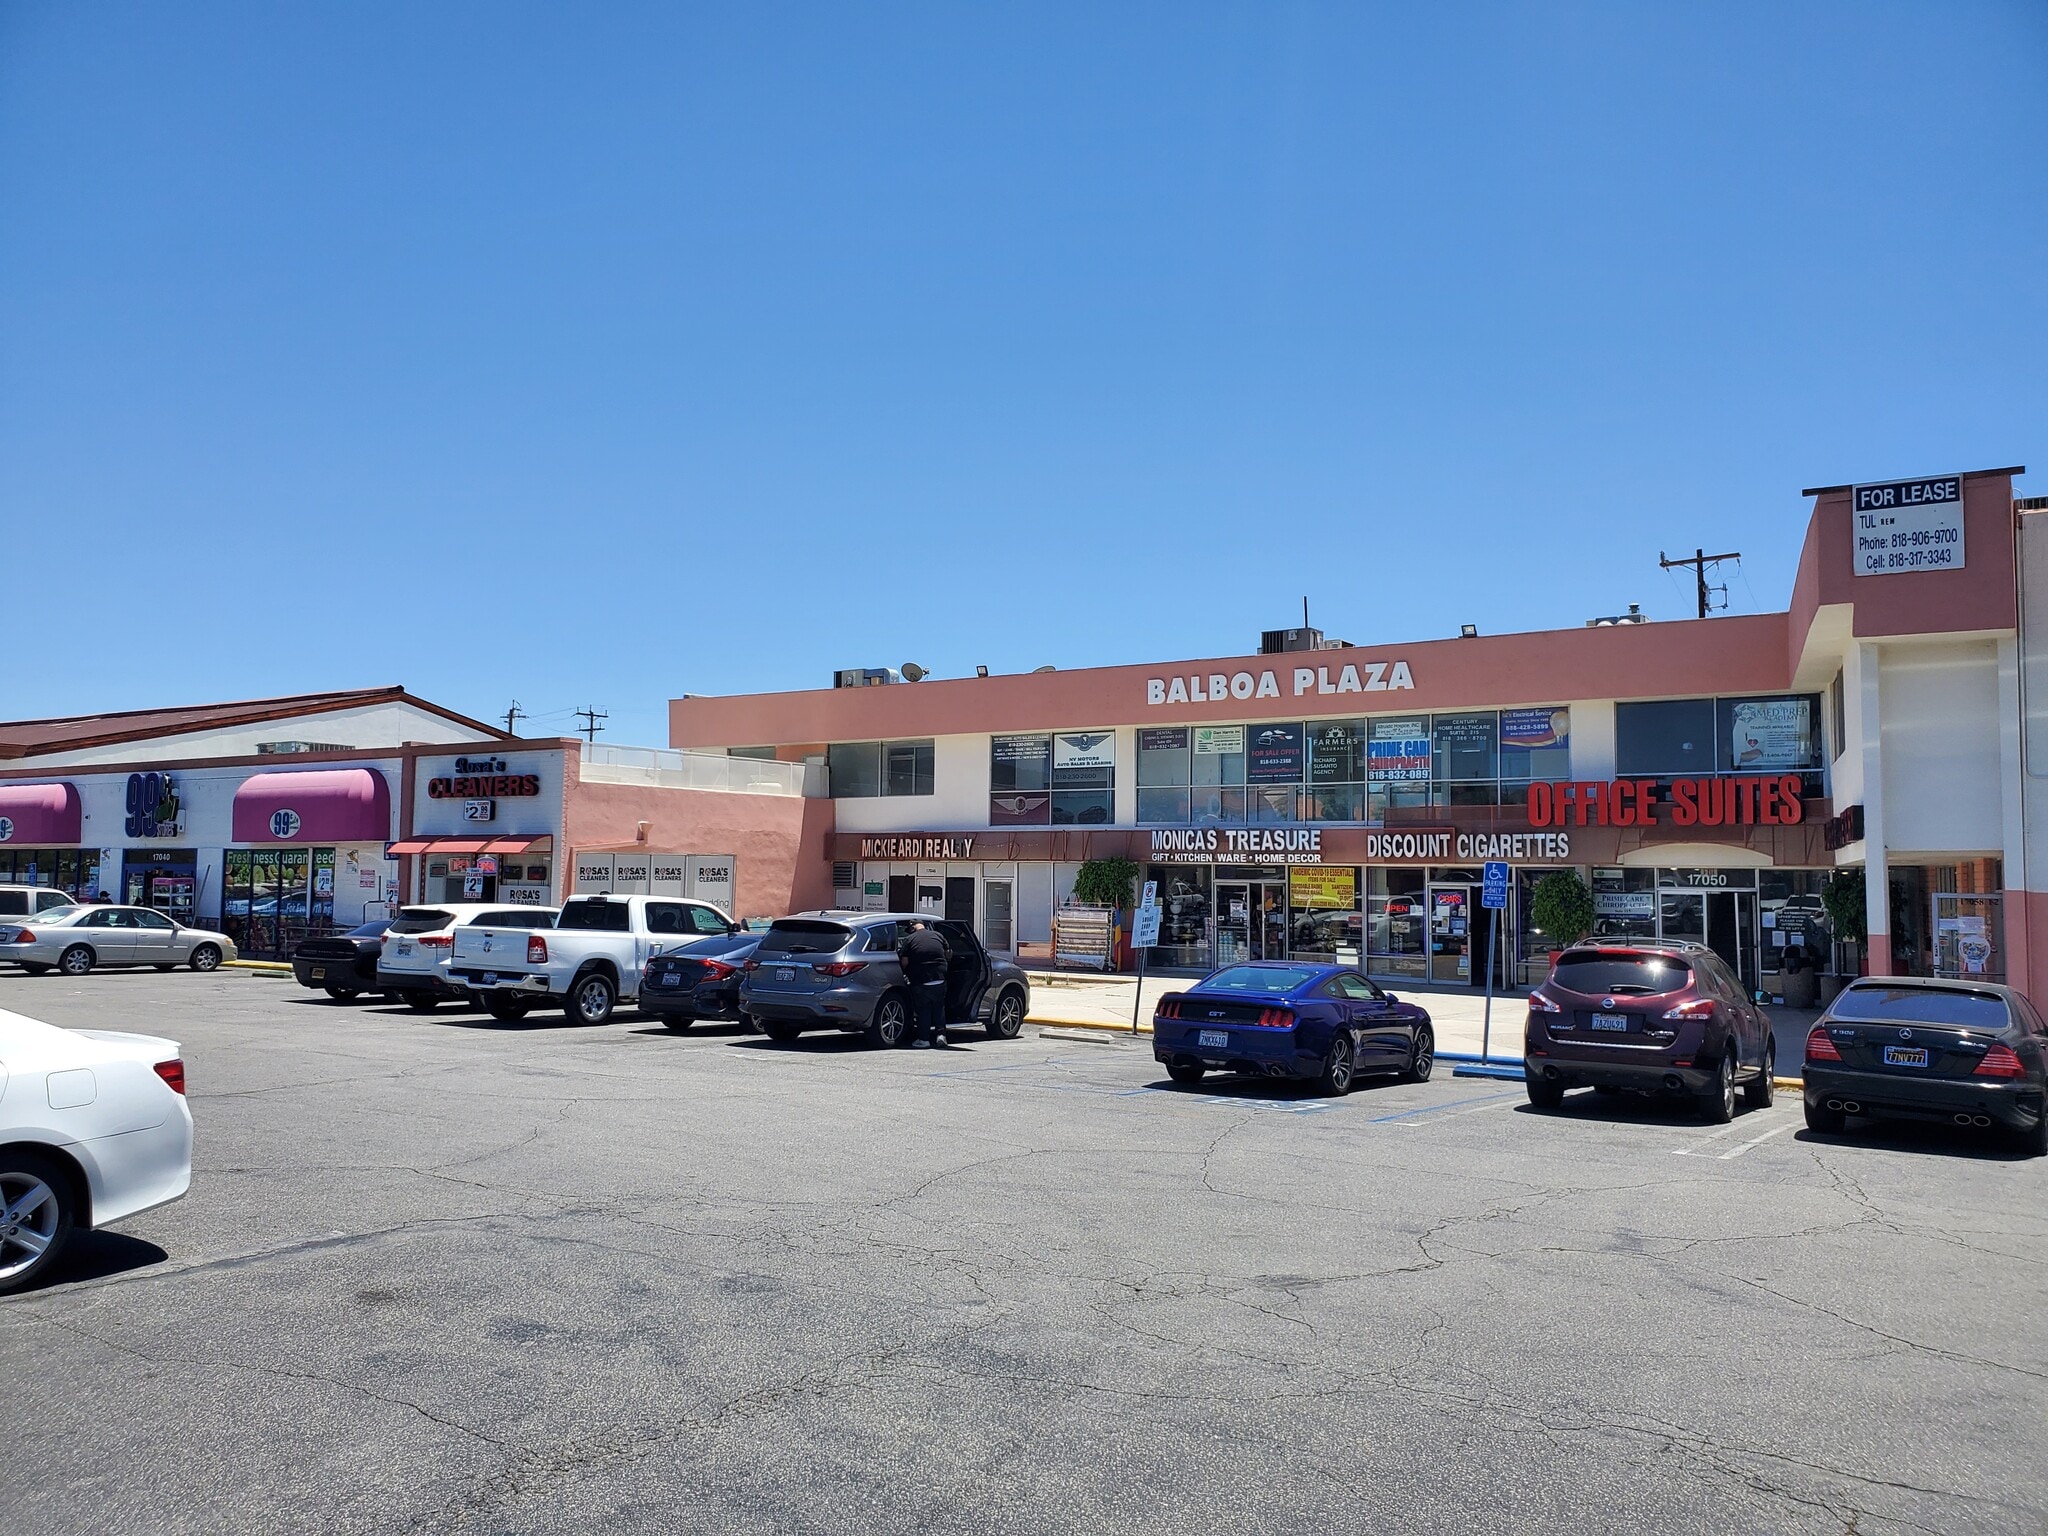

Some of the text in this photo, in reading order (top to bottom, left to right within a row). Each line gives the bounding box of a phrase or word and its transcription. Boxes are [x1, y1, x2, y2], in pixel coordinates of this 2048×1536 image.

[1861, 481, 1956, 508] FOR LEASE
[1859, 514, 1877, 529] TUL
[1859, 528, 1958, 551] Phone: 818-906-9700
[1866, 548, 1952, 569] Cell: 818-317-3343
[1147, 661, 1415, 705] BALBOA PLAZA
[1313, 738, 1358, 746] FARMERS
[428, 775, 539, 798] CLEANERS
[125, 773, 160, 838] 99
[1527, 775, 1804, 827] OFFICE SUITES
[274, 812, 290, 835] 99
[1225, 828, 1321, 851] TREASURE
[1368, 833, 1570, 858] DISCOUNT CIGARETTES
[861, 838, 896, 858] MICKIE
[897, 838, 922, 858] ARDI
[153, 853, 171, 861] 17040
[1151, 853, 1321, 863] GIFT KITCHEN WARE HOME DECOR
[579, 867, 609, 875] ROSA'S
[618, 867, 647, 875] ROSA'S
[654, 867, 682, 875] ROSA'S
[699, 868, 728, 876] ROSA'S
[1291, 868, 1311, 876] PANDEMIC
[1330, 868, 1354, 877] ESSENTIALS
[1485, 879, 1506, 888] PARKING
[1687, 873, 1727, 886] 17050
[509, 889, 541, 900] ROSA'S
[1383, 904, 1408, 912] OPEN
[1888, 1052, 1925, 1063] 77NV777
